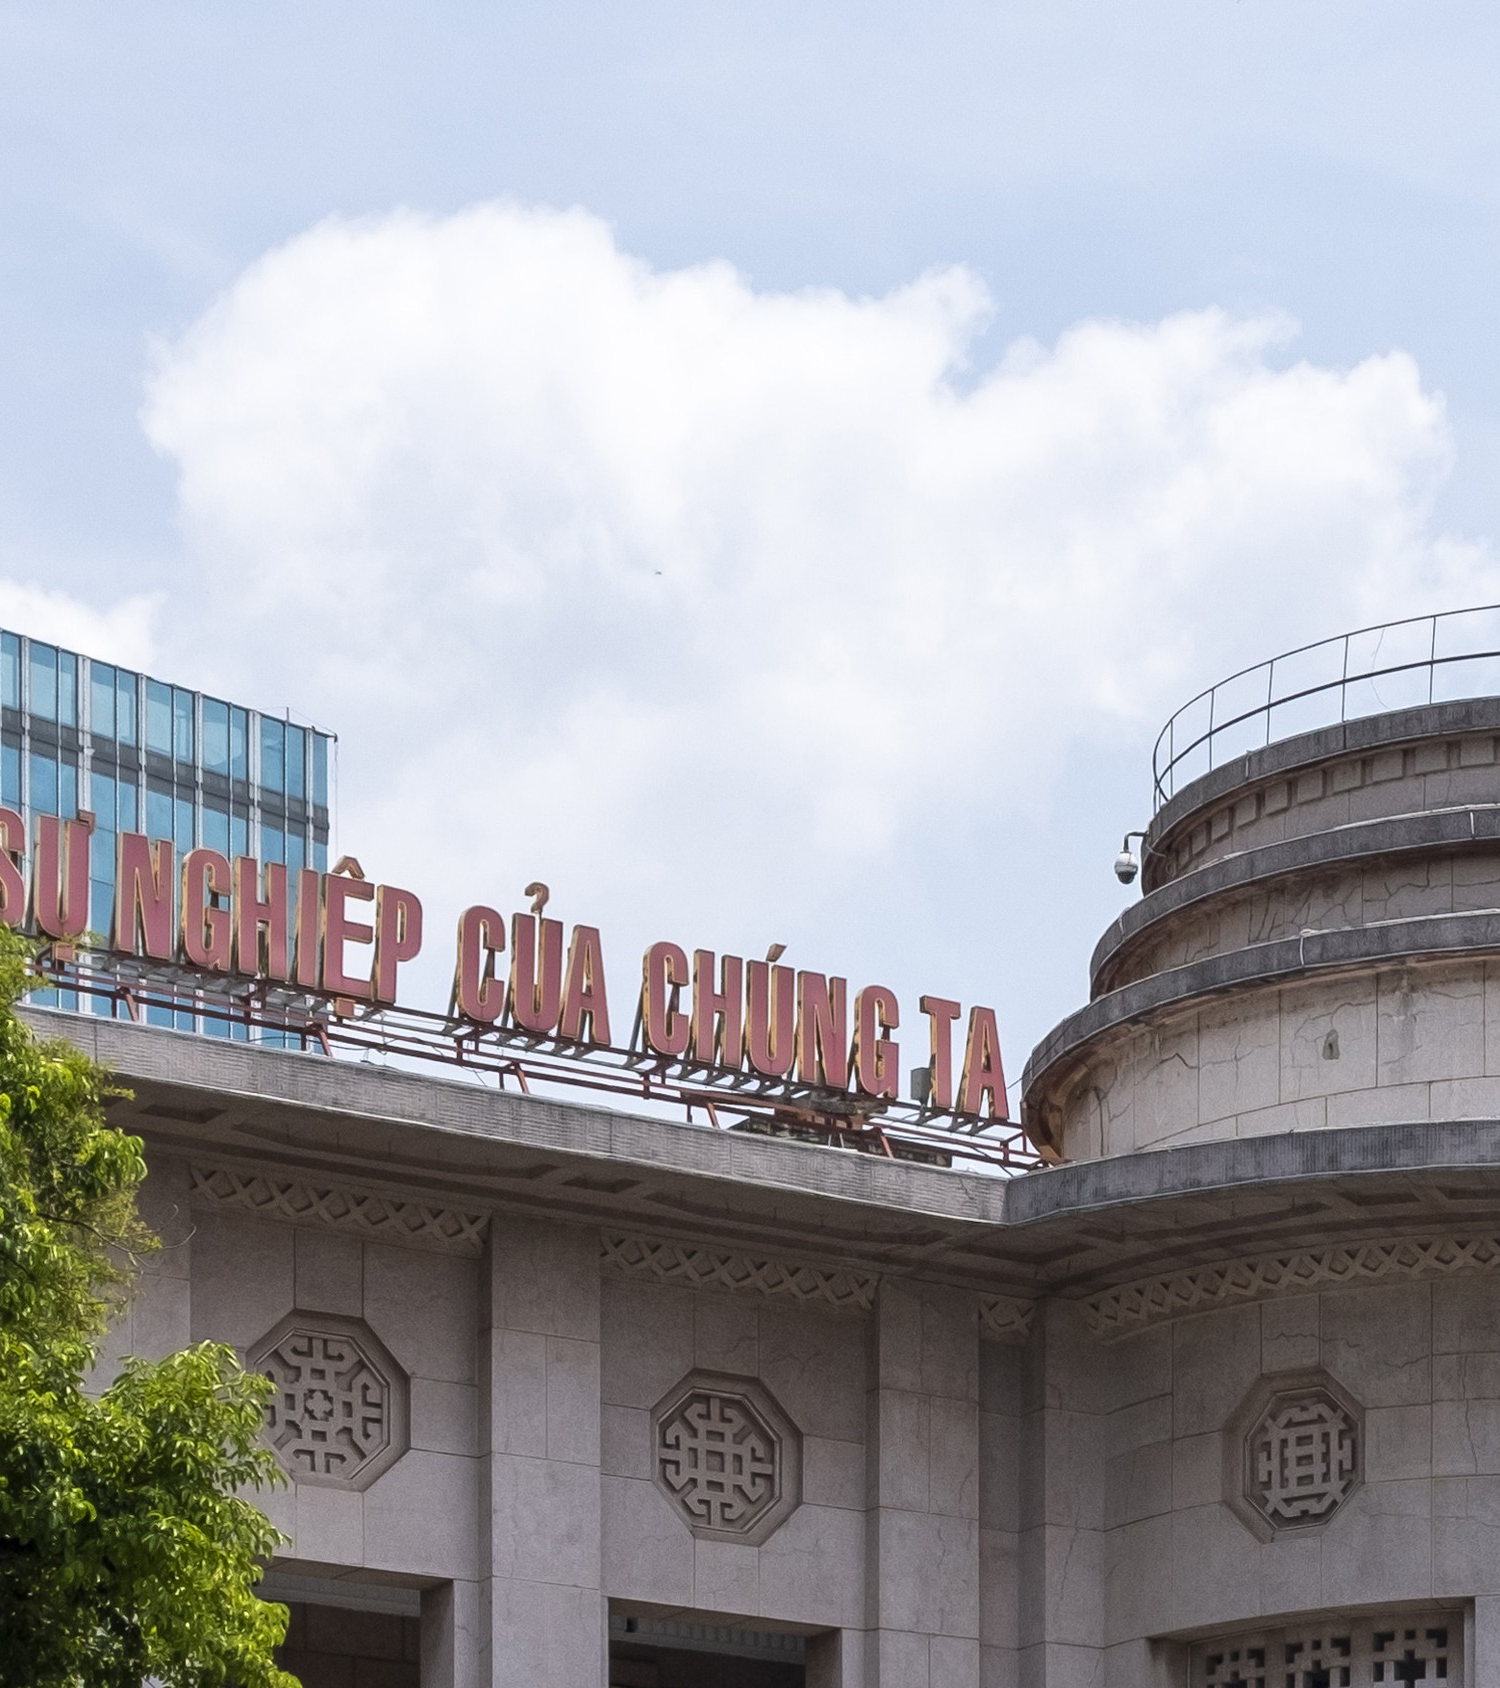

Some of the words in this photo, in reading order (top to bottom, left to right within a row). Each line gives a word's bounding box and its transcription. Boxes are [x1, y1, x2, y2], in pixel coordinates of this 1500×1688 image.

[115, 832, 422, 1015] NGHIỆP
[455, 883, 610, 1045] CỦA
[641, 942, 899, 1098] CHÚNG
[919, 995, 1009, 1121] TA
